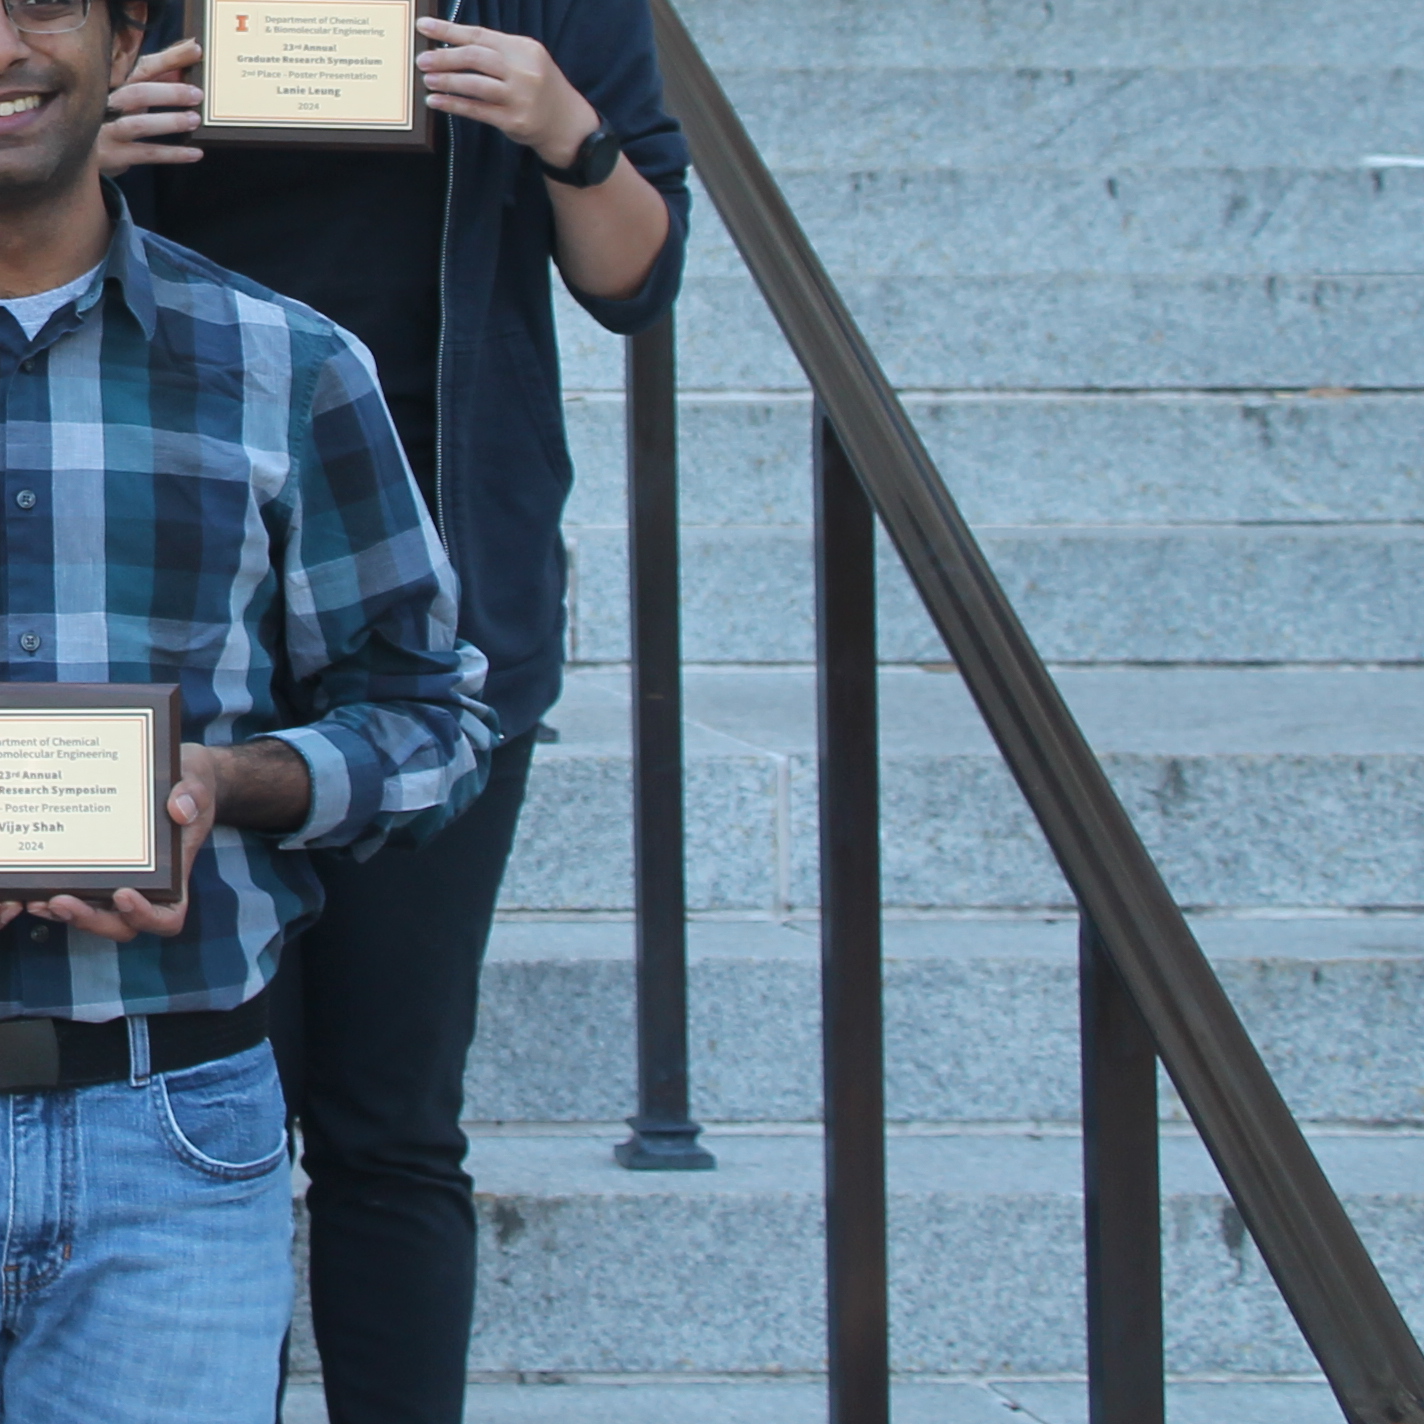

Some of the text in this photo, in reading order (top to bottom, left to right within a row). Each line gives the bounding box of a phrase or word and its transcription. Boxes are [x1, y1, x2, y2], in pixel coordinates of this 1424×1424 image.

[265, 15, 370, 26] Department of Chemical
[274, 26, 331, 35] Biomolecular
[333, 27, 385, 37] Engineering
[303, 43, 337, 52] Annual
[237, 55, 383, 67] Graduate Research Symposium
[257, 70, 281, 79] Place
[288, 71, 317, 80] Poster
[319, 71, 377, 80] Presentation
[277, 86, 341, 98] Lanie Leung
[298, 102, 319, 111] 2024
[39, 737, 50, 747] of
[52, 737, 99, 747] Chemical
[57, 749, 118, 761] Engineering
[22, 771, 62, 780] Annual
[51, 785, 117, 798] Symposium
[5, 803, 39, 813] Poster
[41, 803, 111, 813] Presentation
[33, 822, 64, 832] Shah
[18, 841, 44, 851] 2024
